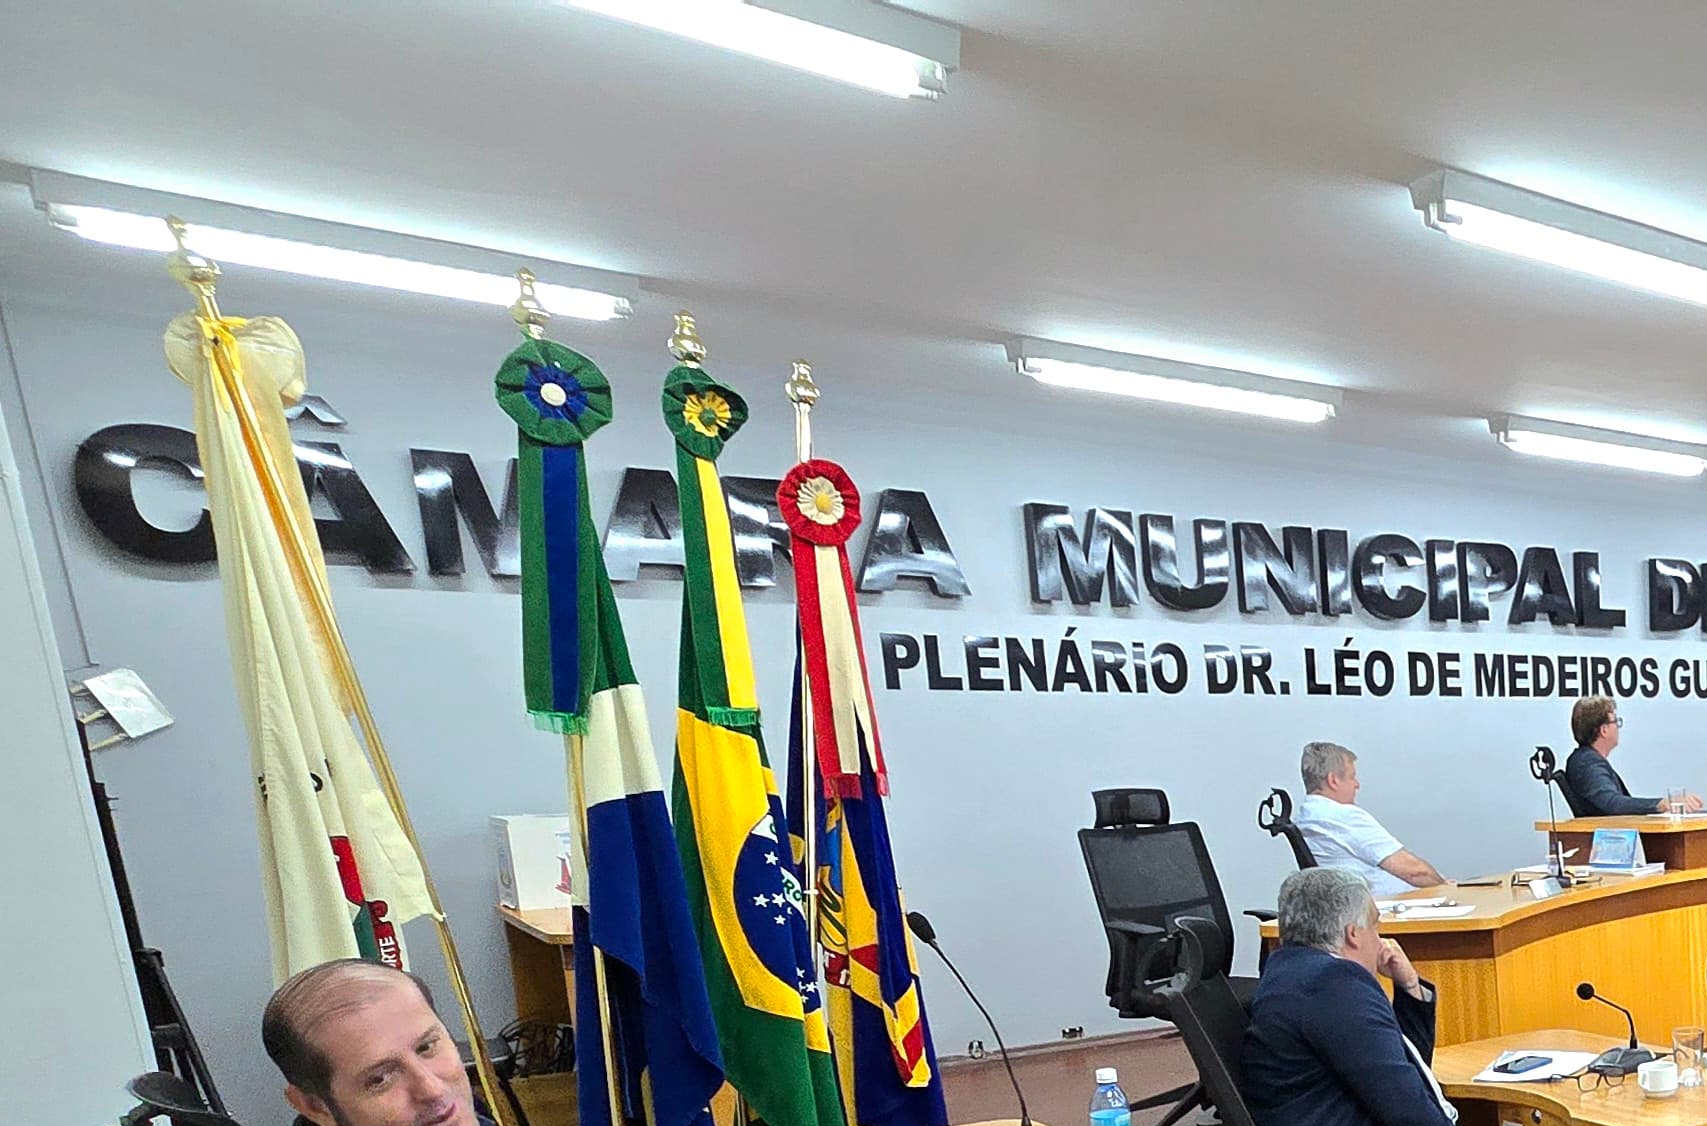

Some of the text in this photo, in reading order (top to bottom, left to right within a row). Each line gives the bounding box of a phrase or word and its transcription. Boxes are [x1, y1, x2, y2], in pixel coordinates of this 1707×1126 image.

[1023, 503, 1626, 628] MUNICIPAL
[880, 627, 1189, 695] PLENÁRIO
[1203, 644, 1291, 695] DR.
[1303, 637, 1395, 698] LÉO
[1408, 651, 1463, 698] DE
[1473, 652, 1660, 699] MEDEIROS
